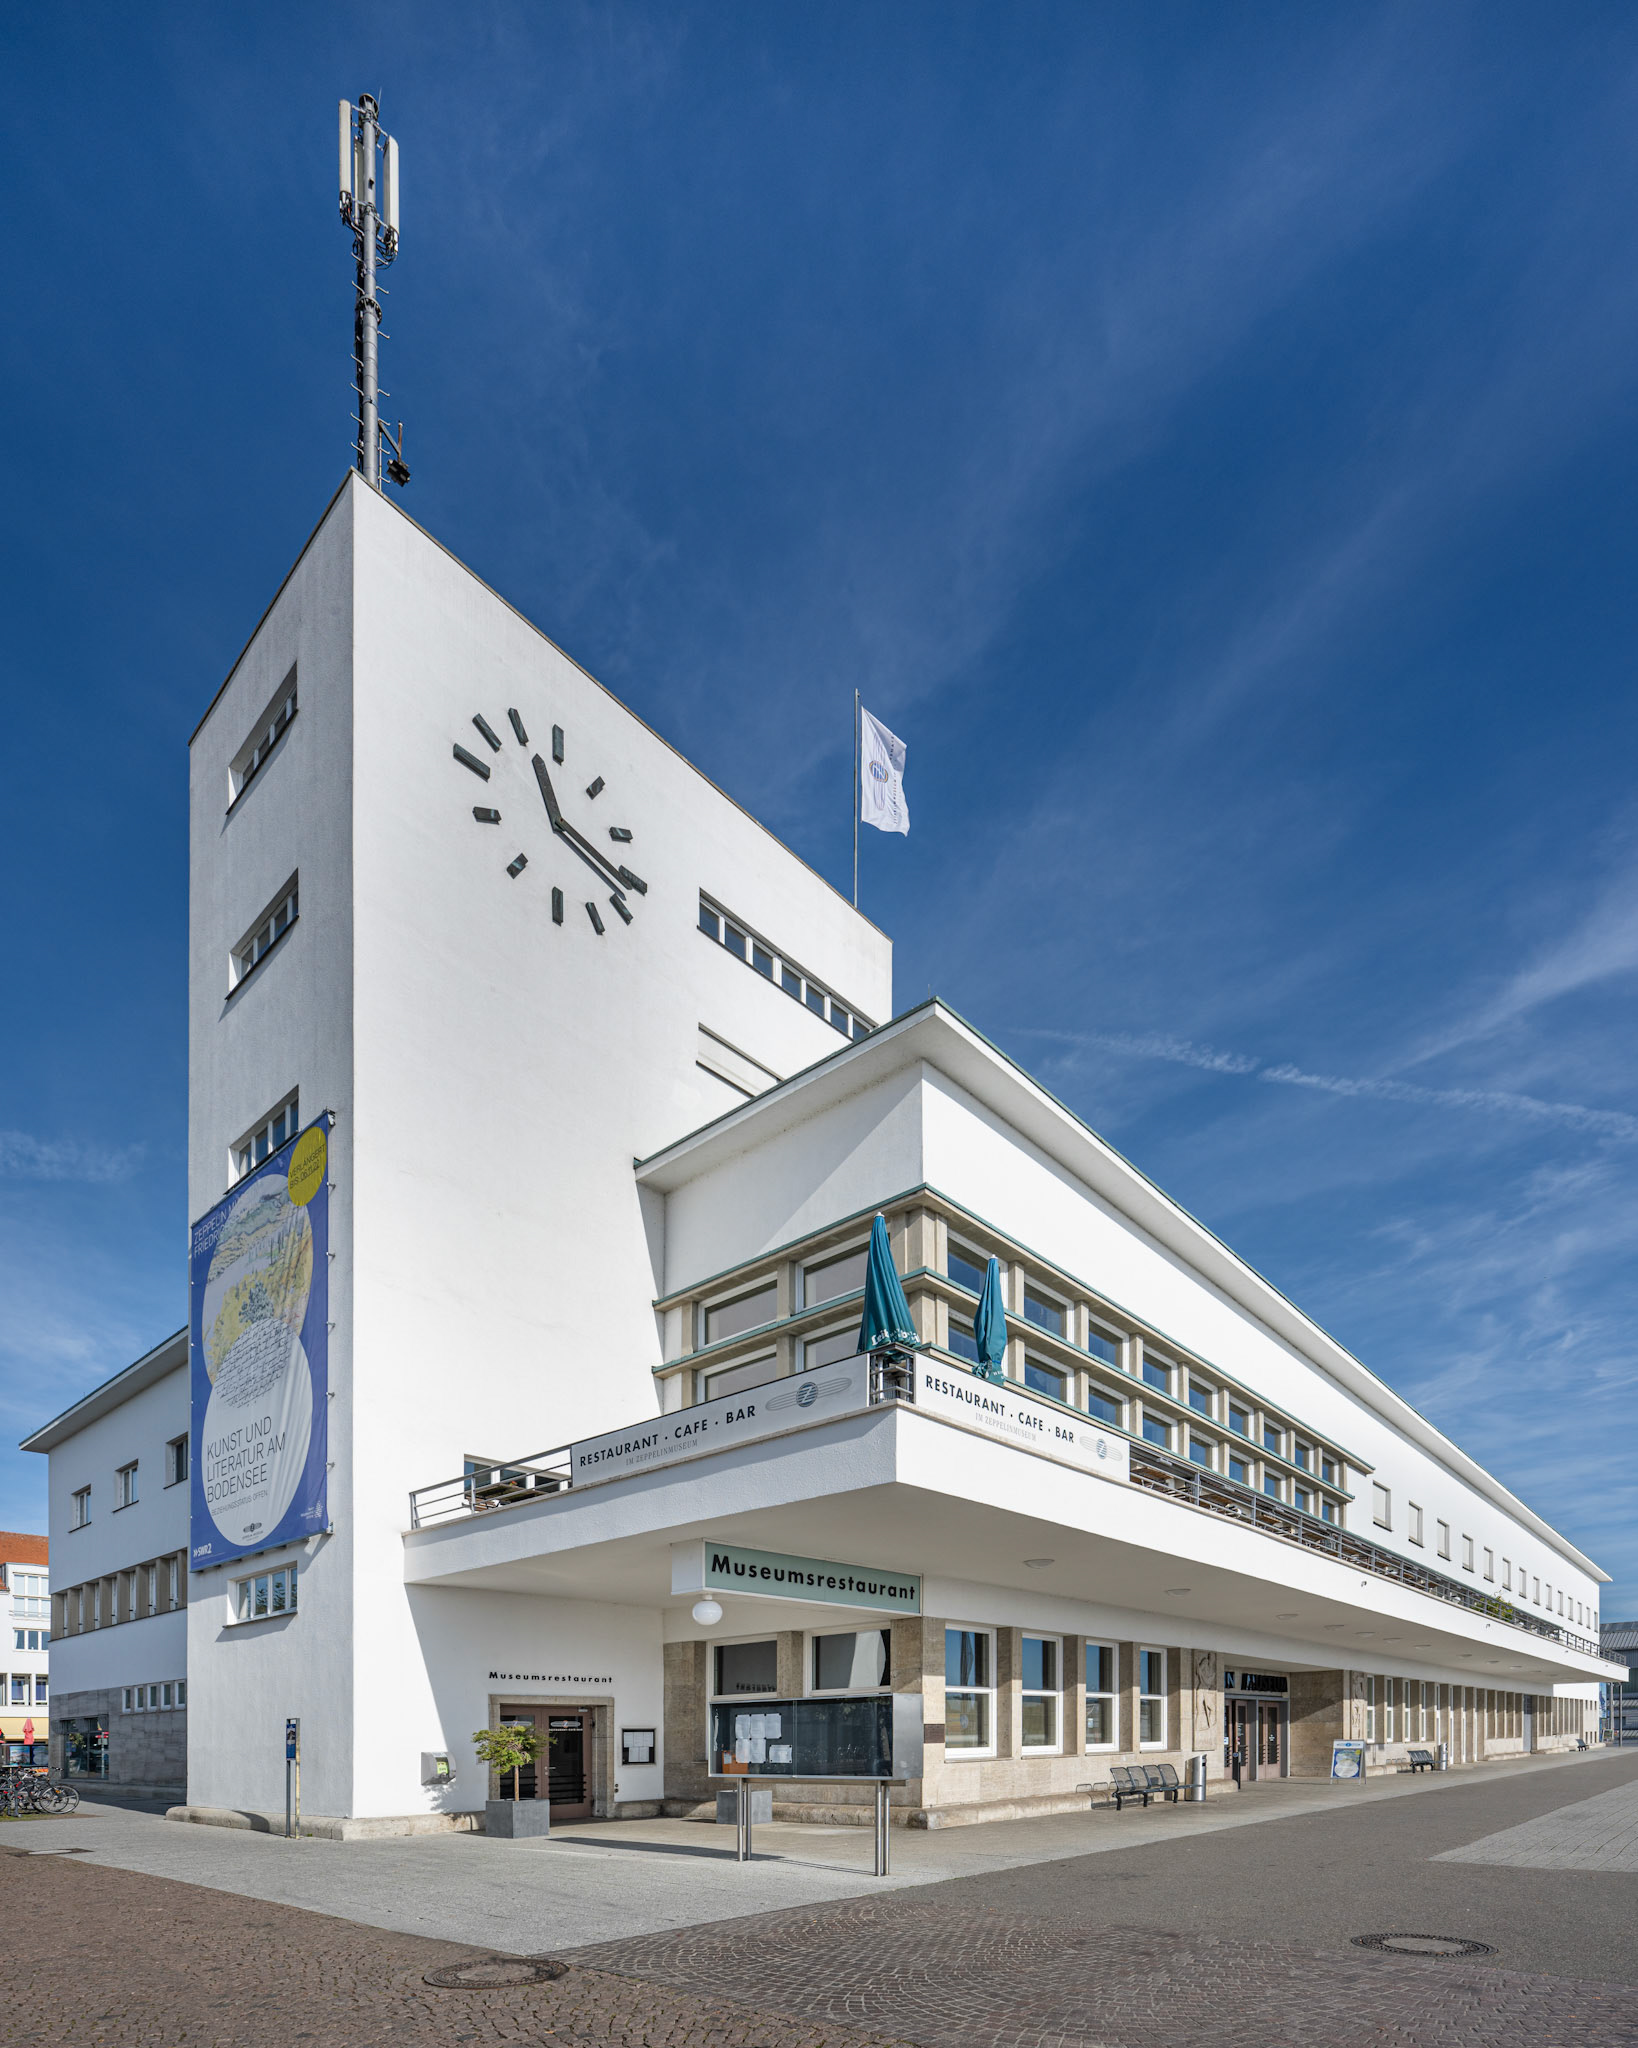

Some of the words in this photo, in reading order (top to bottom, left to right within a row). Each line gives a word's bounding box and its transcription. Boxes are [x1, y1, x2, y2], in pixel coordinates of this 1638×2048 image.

[926, 1375, 1005, 1416] RESTAURANT
[1018, 1412, 1044, 1431] CAFE
[1055, 1426, 1074, 1443] BAR
[207, 1429, 243, 1461] KUNST
[245, 1416, 272, 1443] UND
[207, 1442, 264, 1483] LITERATUR
[267, 1431, 286, 1457] AM
[580, 1434, 659, 1467] RESTAURANT
[674, 1419, 708, 1439] CAFE
[726, 1405, 756, 1424] BAR
[625, 1457, 634, 1466] IM
[636, 1439, 698, 1463] ZEPPELINMUSEUM
[207, 1463, 268, 1504] BODENSEE
[711, 1553, 916, 1600] Museumsrestaurant
[488, 1671, 613, 1683] Museumsrestaurant
